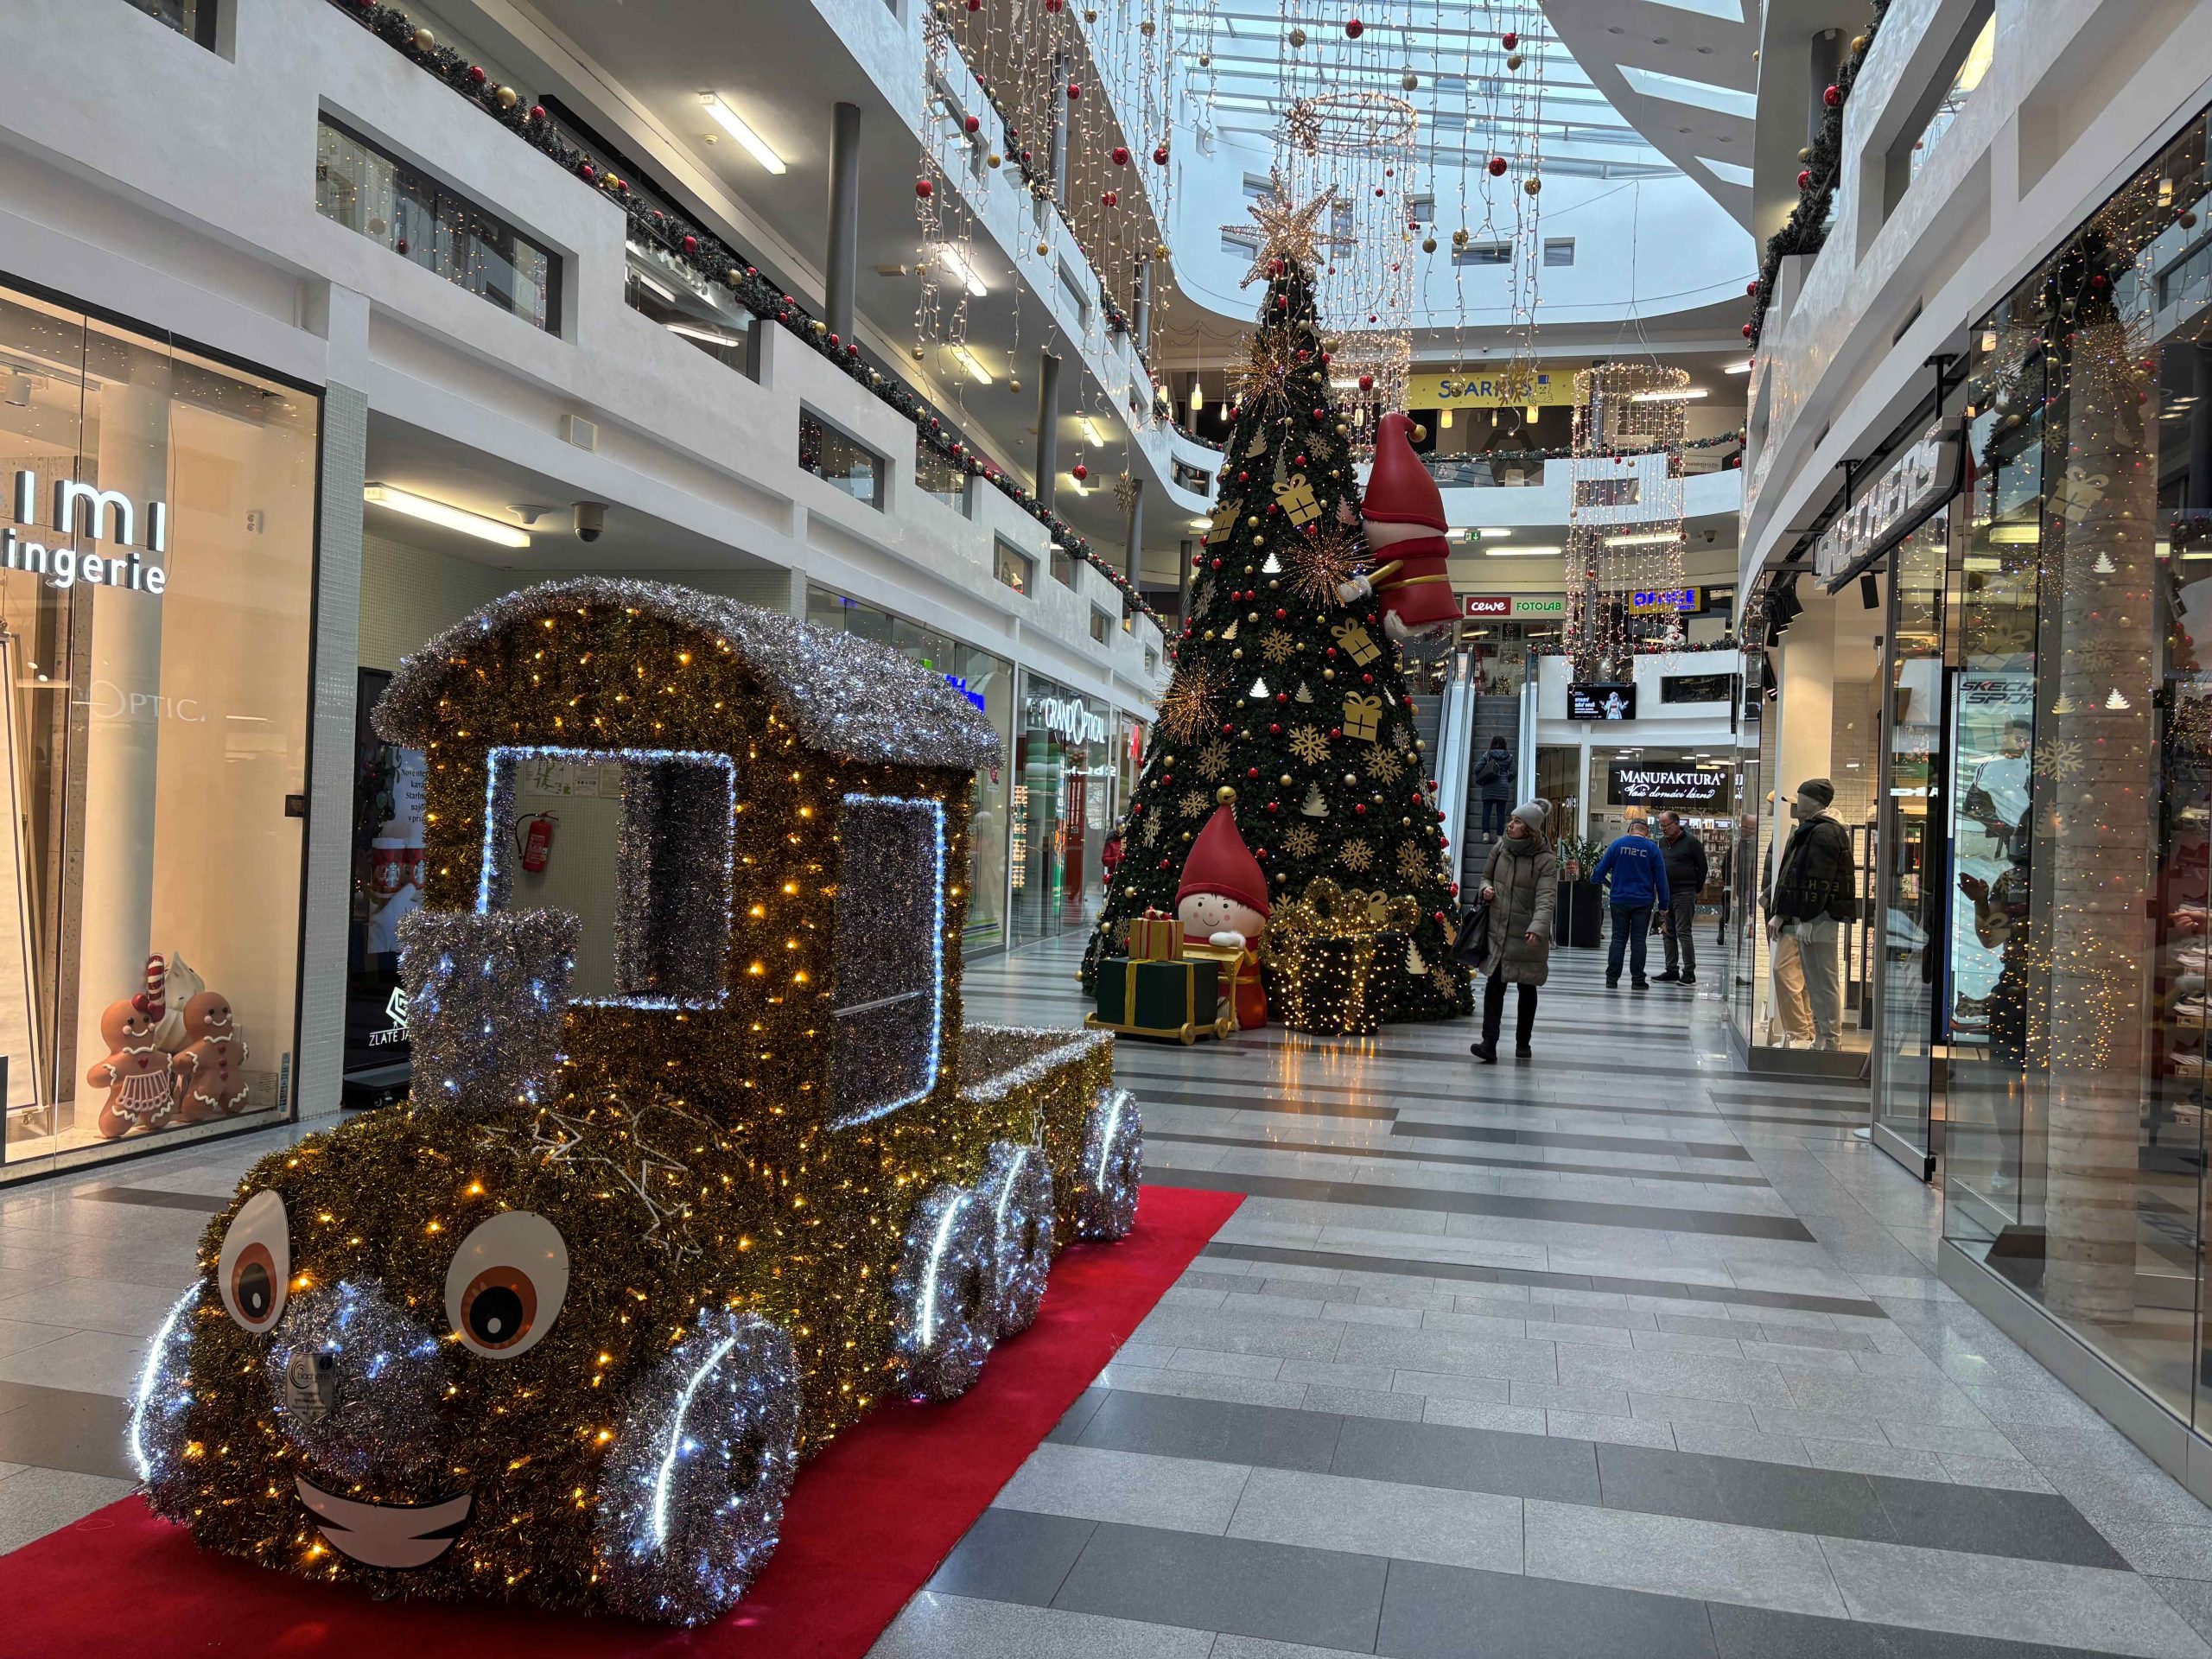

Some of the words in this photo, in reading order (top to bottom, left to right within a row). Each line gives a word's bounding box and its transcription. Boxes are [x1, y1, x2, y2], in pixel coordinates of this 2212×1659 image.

[1471, 601, 1507, 613] cewe
[1516, 601, 1561, 612] FOTOLAB
[1960, 680, 2033, 692] SKECH
[87, 679, 206, 722] OPTIC
